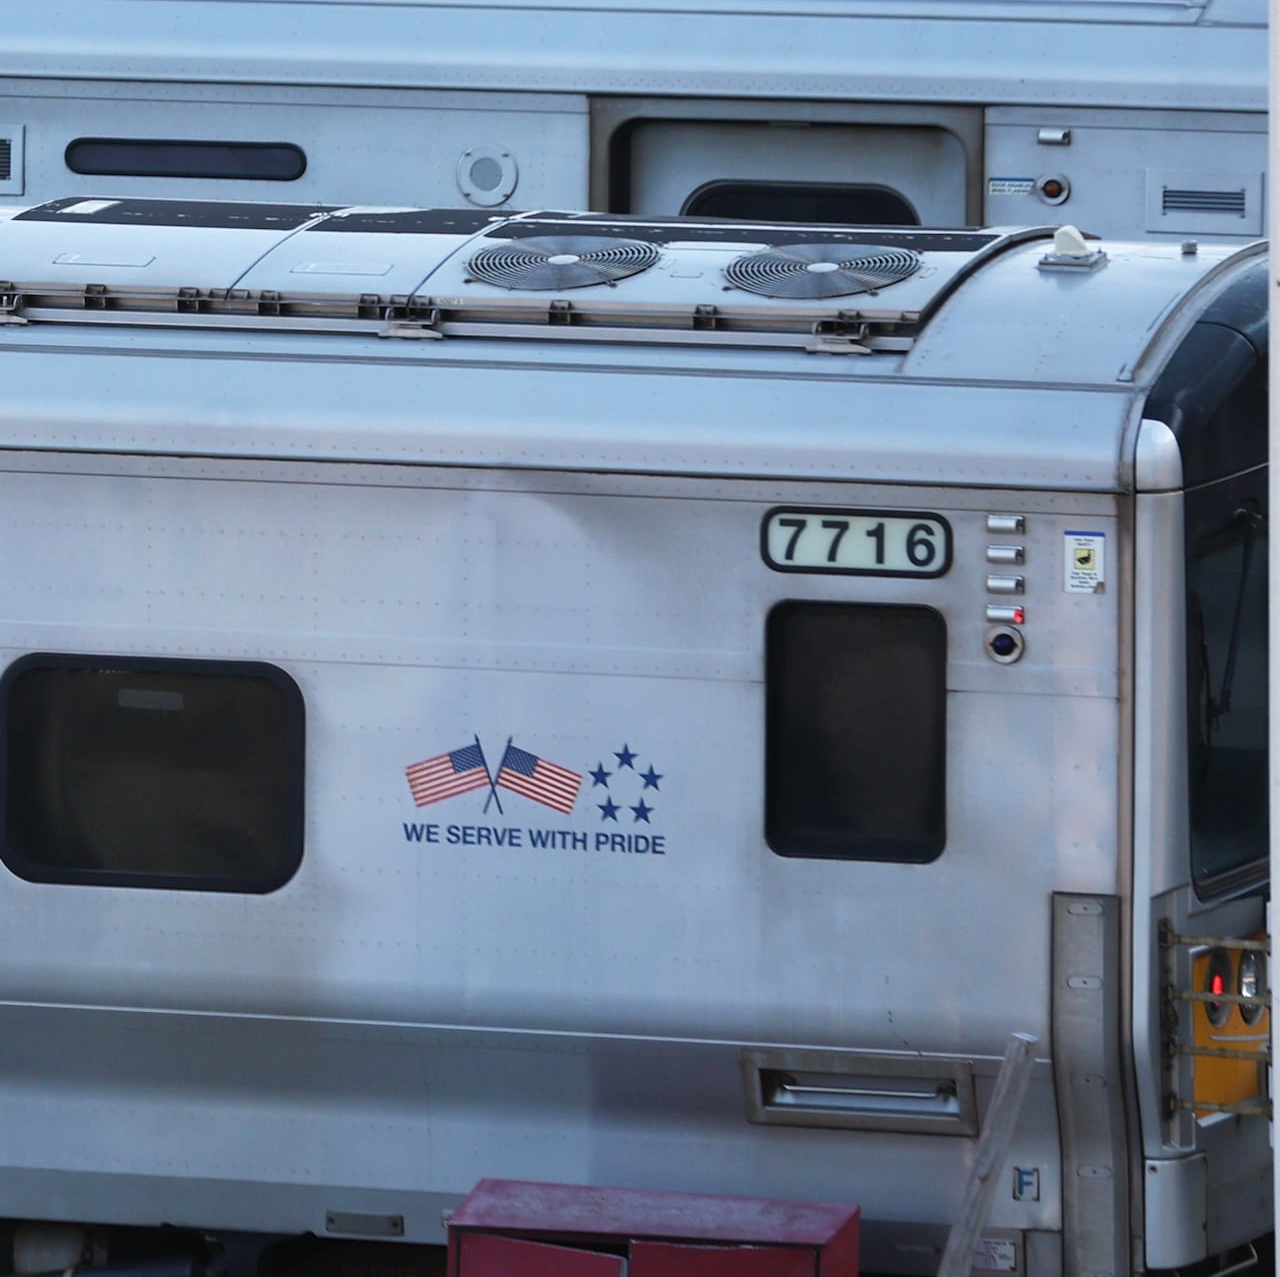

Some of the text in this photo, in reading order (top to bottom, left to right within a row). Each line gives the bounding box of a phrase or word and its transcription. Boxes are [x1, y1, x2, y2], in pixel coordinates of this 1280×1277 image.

[779, 518, 936, 567] 7716
[403, 822, 666, 855] WE SERVE WITH PRIDE
[1017, 1170, 1035, 1196] F
